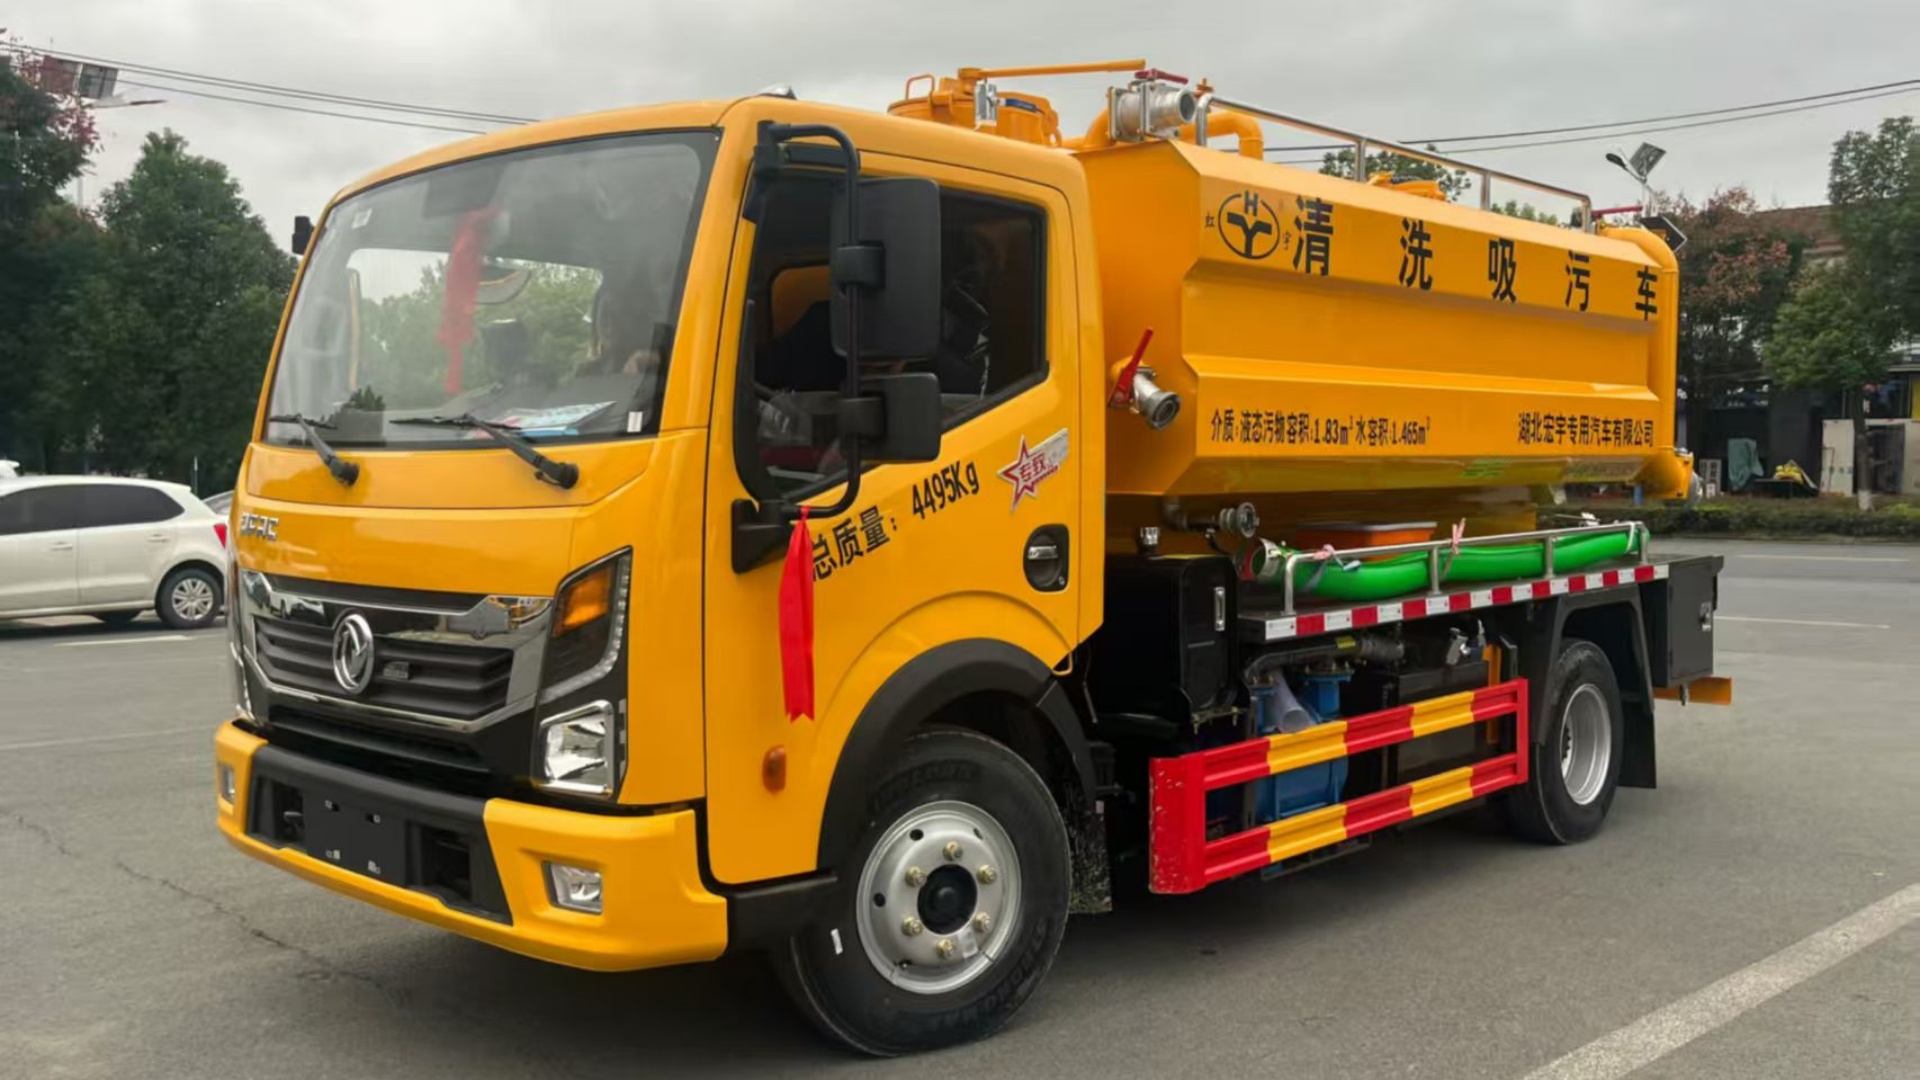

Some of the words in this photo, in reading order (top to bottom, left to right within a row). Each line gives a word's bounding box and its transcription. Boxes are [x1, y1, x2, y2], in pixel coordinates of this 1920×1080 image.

[1293, 195, 1660, 321] 清洗吸污车
[1518, 411, 1653, 447] 湖北宏宇专用汽车有限公司
